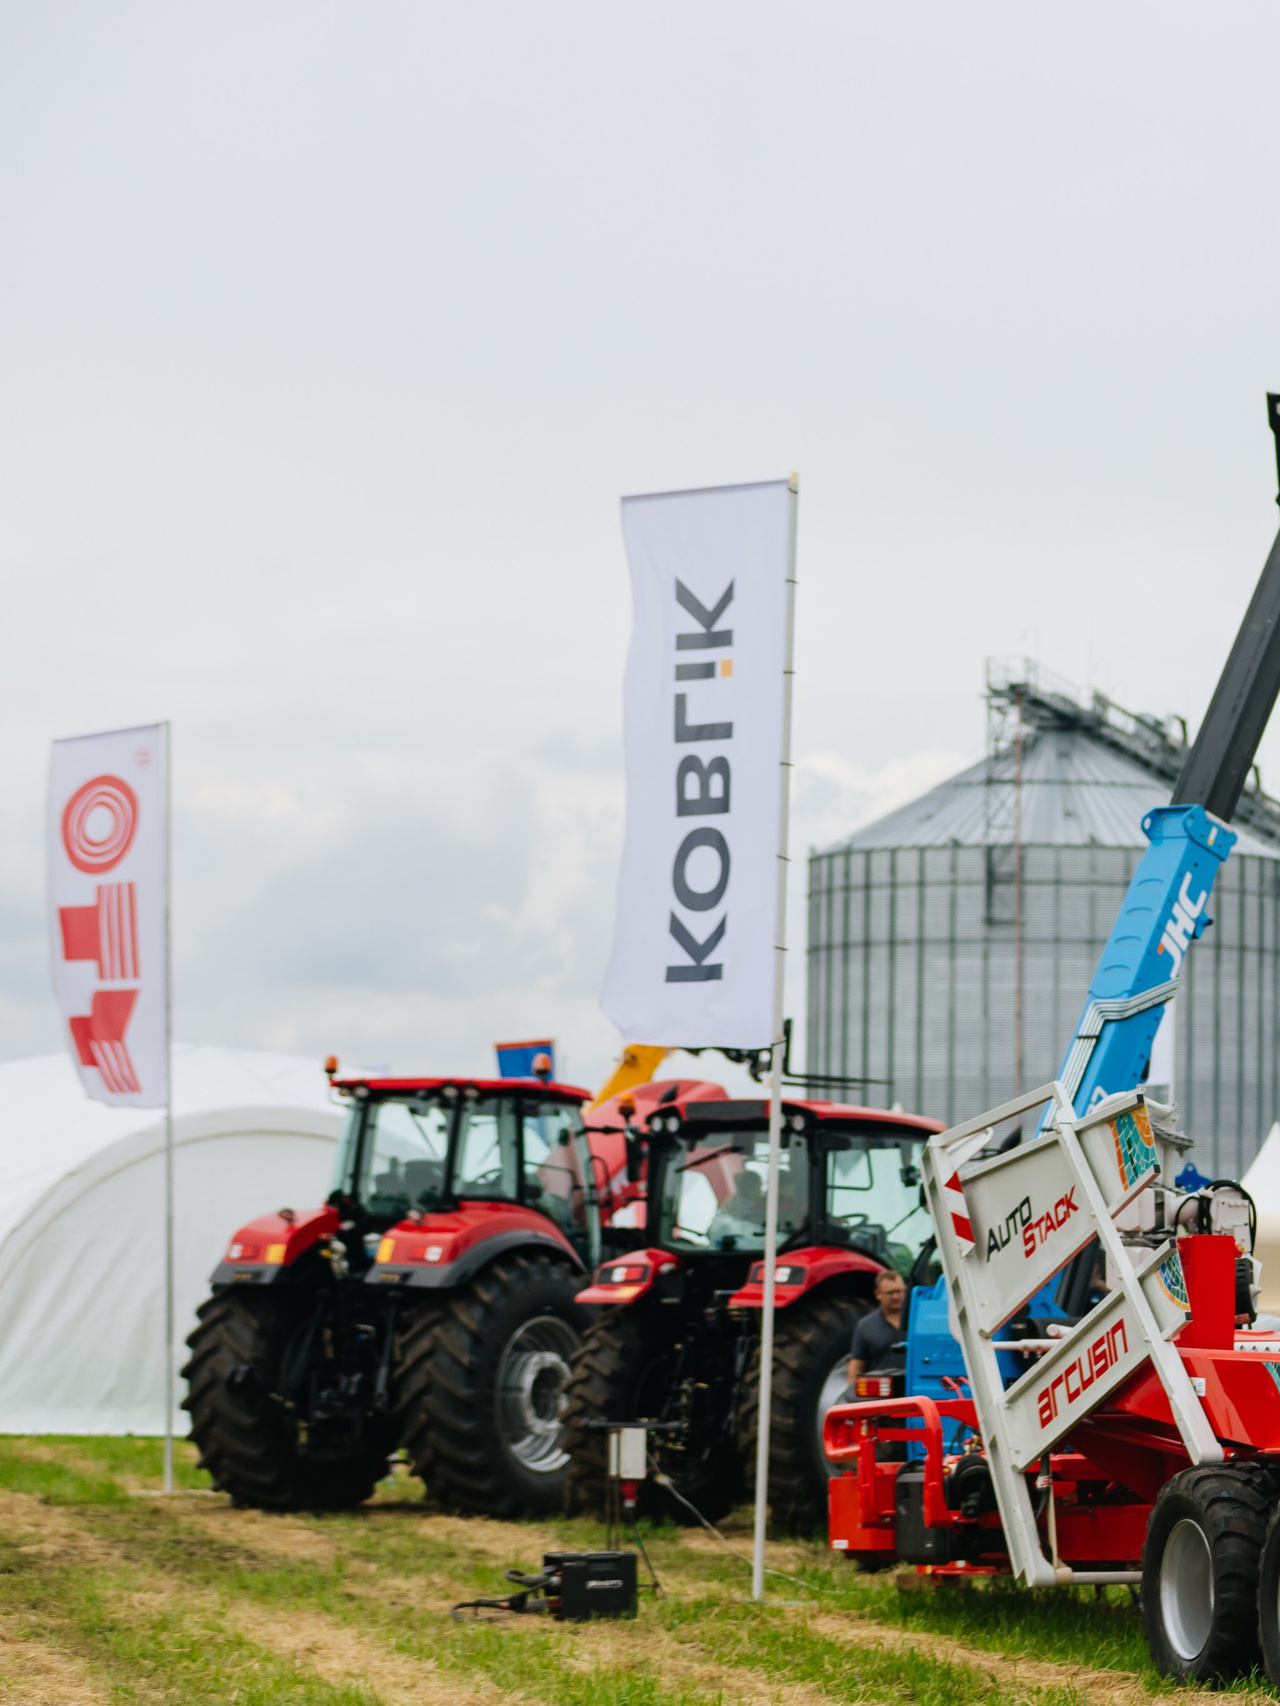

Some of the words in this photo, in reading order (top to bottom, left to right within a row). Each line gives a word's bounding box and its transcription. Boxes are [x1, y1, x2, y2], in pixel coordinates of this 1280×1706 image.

[986, 1196, 1034, 1263] AUTO
[1022, 1185, 1080, 1259] STACK
[1037, 1318, 1129, 1429] arcusin
